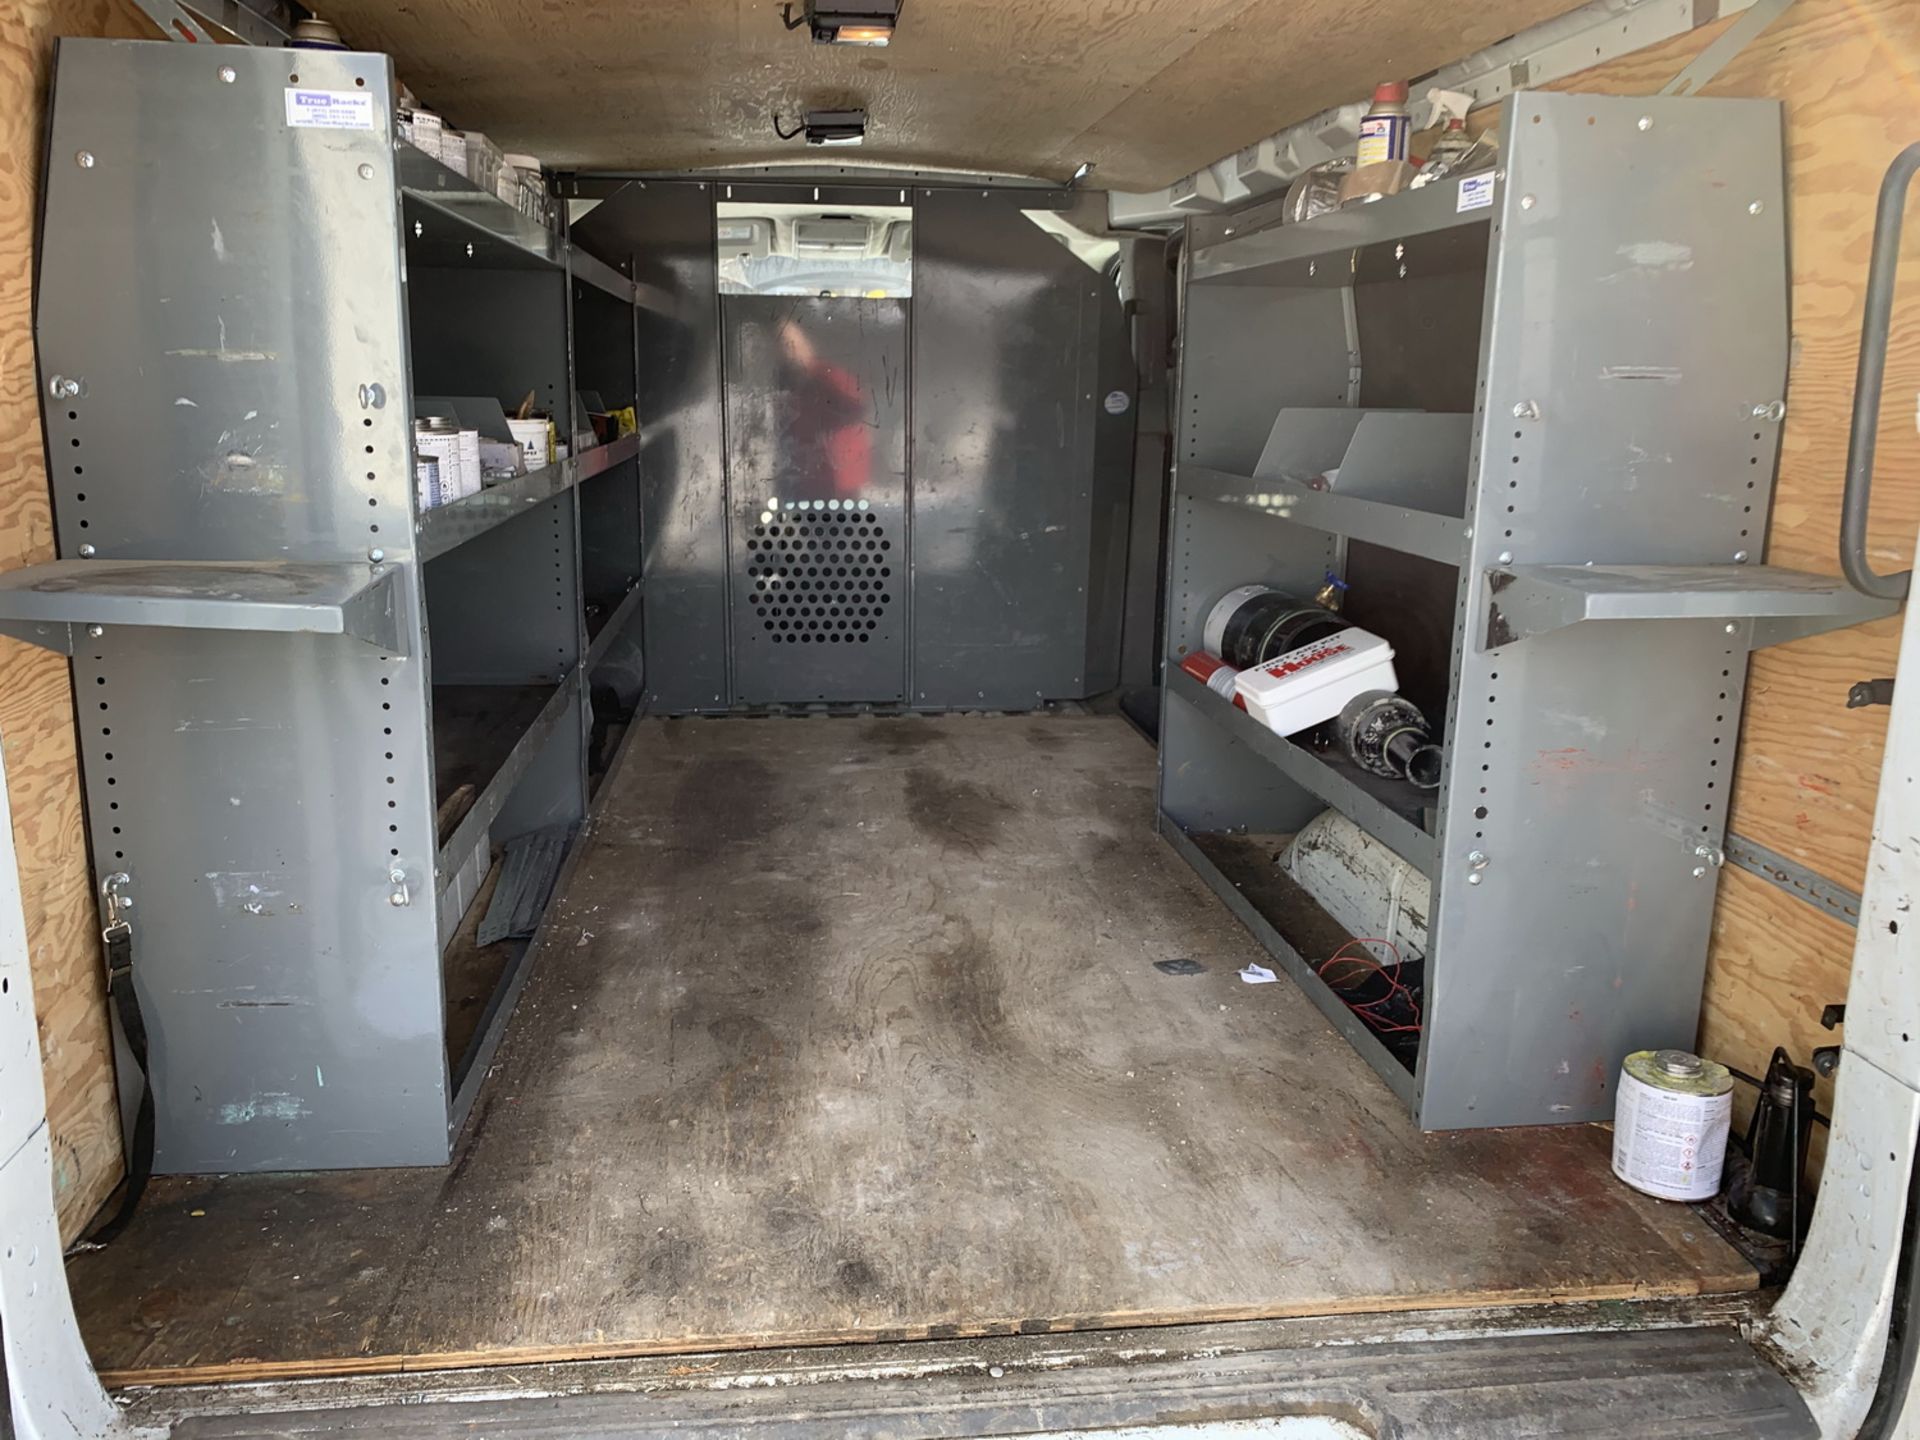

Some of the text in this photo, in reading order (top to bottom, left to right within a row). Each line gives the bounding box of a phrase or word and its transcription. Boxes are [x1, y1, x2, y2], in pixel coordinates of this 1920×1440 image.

[298, 94, 330, 106] True
[1254, 655, 1291, 672] FIRST
[1321, 634, 1341, 644] KIT
